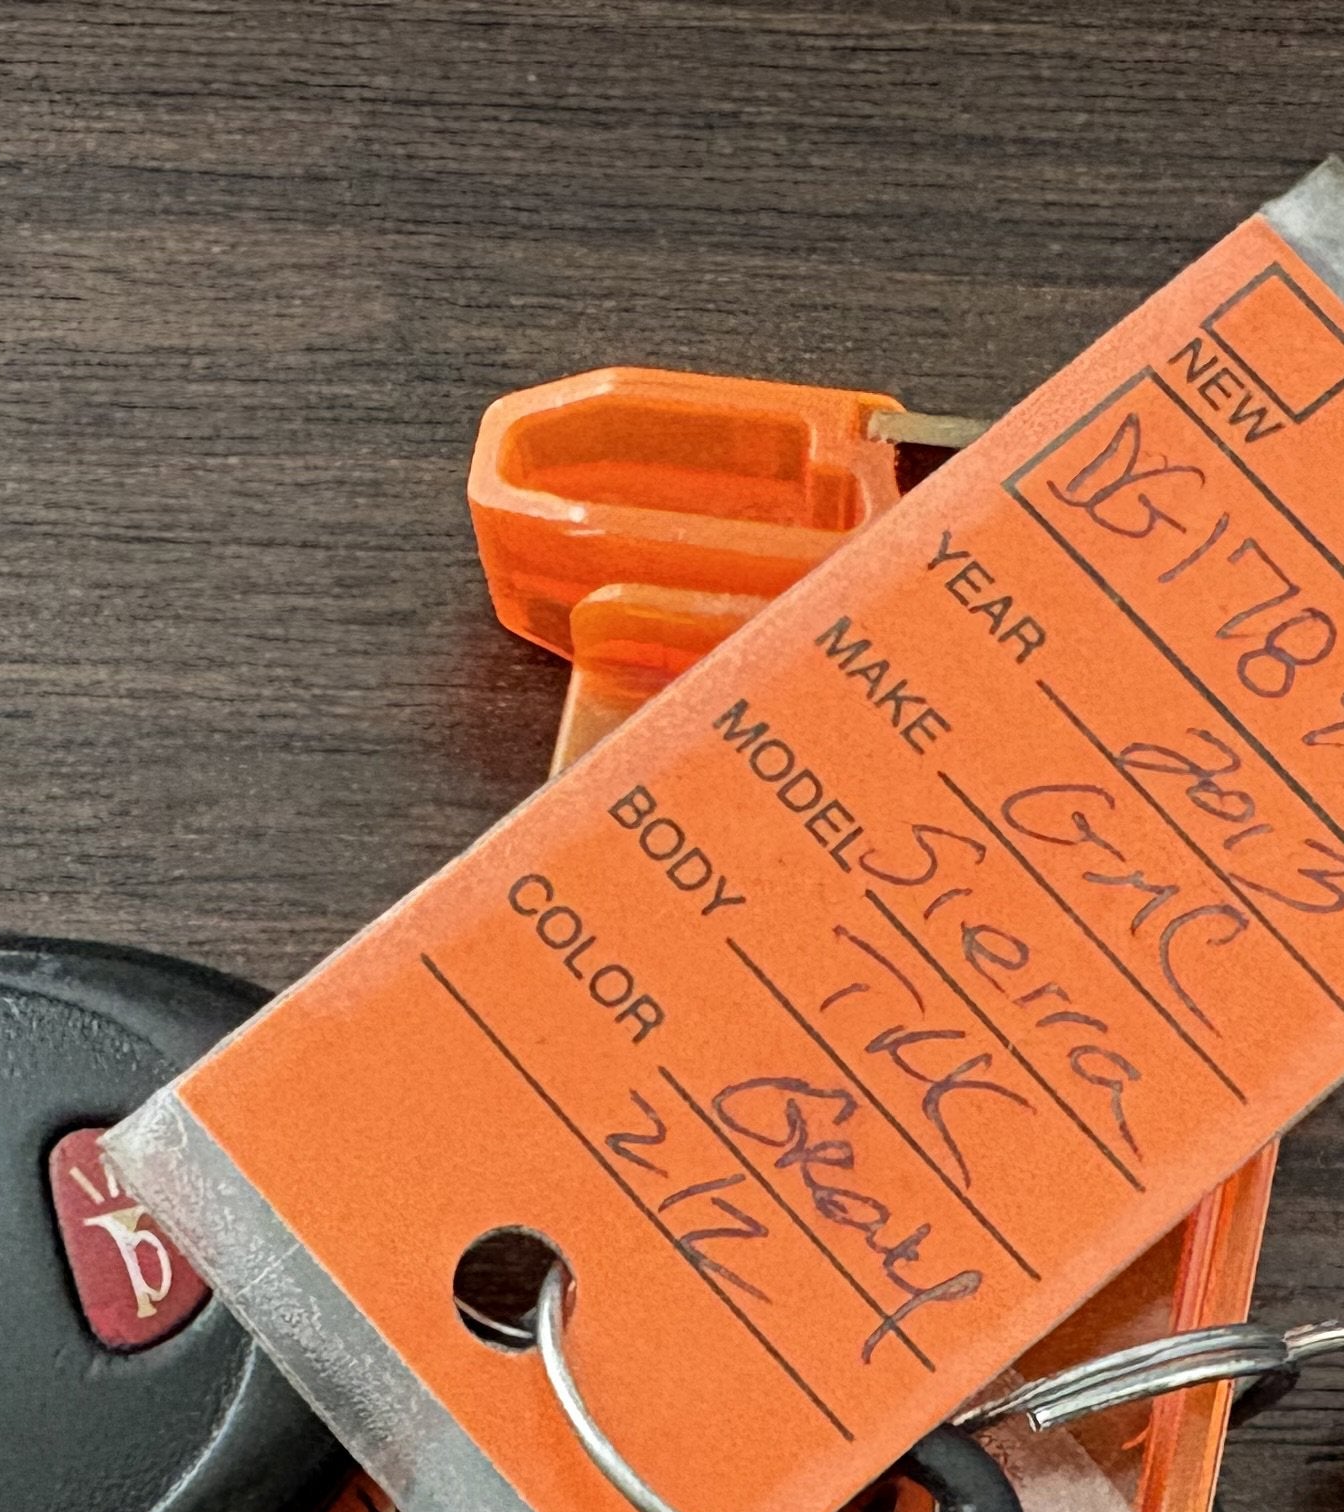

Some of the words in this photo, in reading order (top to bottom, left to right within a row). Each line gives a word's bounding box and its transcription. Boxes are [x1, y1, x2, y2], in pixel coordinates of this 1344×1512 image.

[1168, 337, 1287, 445] NEW
[928, 531, 1047, 664] YEAR
[814, 616, 952, 754] MAKE
[607, 784, 747, 917] BODY
[507, 873, 667, 1043] COLOR
[712, 698, 868, 873] MODEL
[858, 823, 1141, 1162] Sierra
